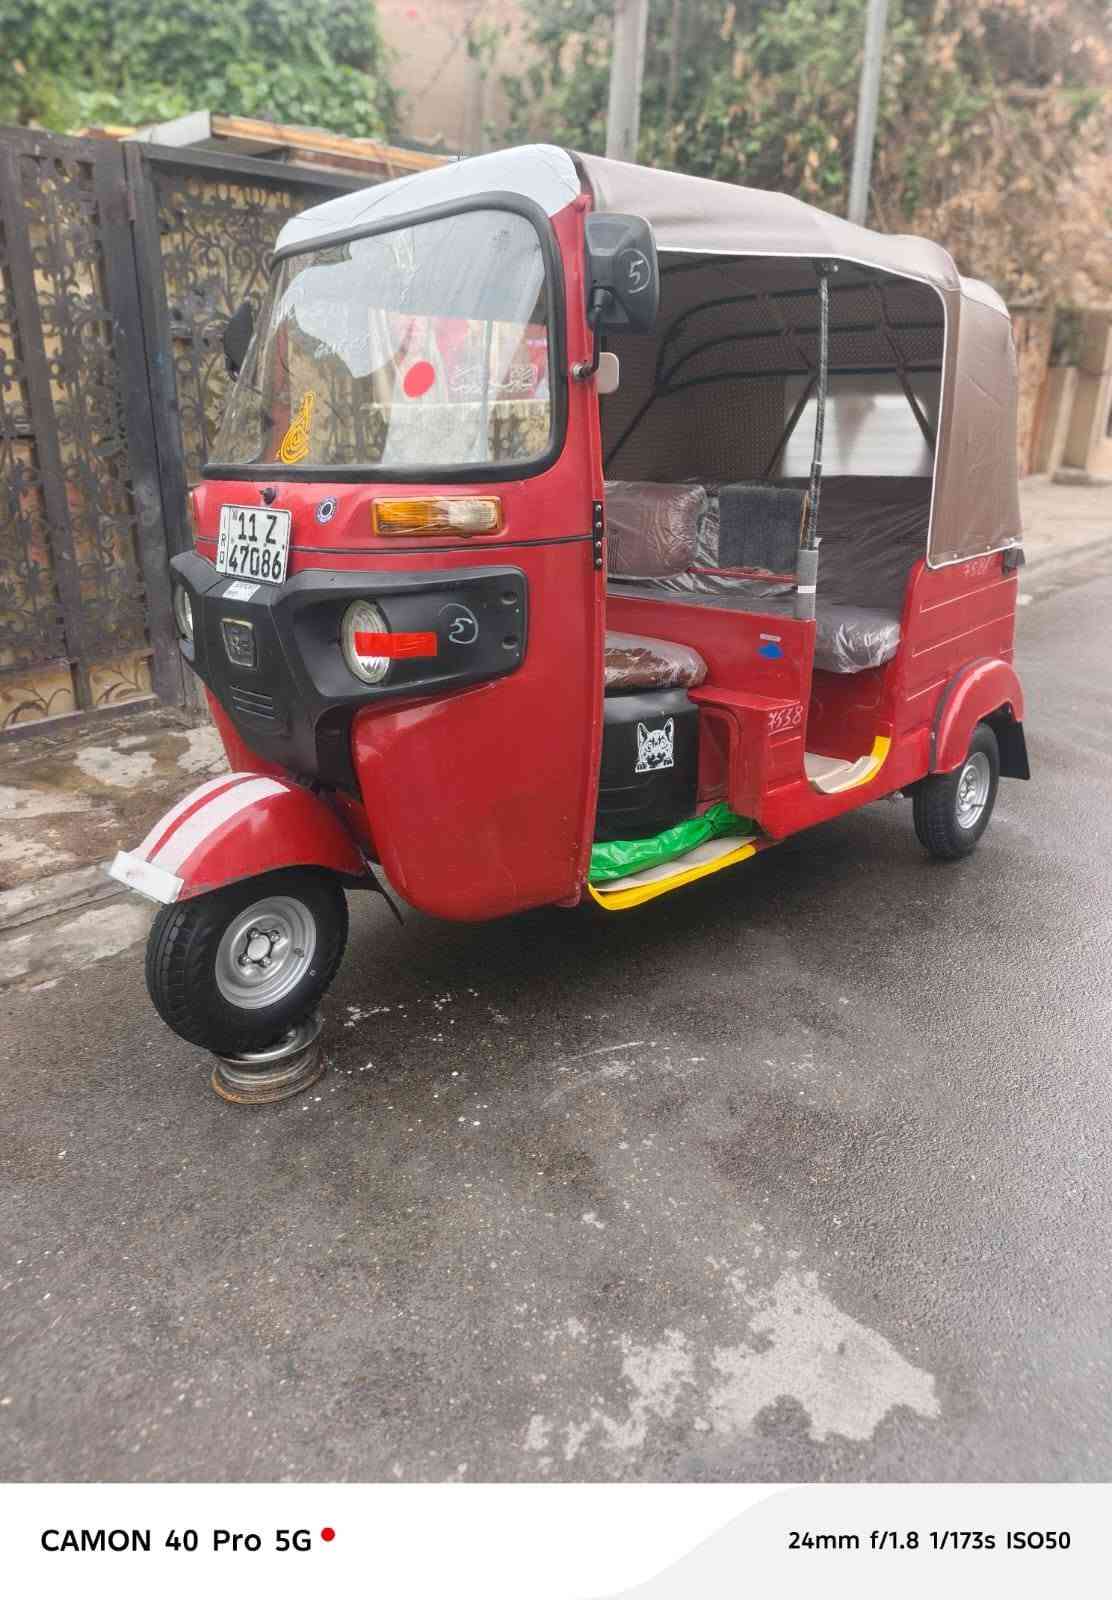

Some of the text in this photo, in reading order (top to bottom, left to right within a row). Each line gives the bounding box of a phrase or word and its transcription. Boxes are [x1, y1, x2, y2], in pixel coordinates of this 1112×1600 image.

[628, 259, 643, 284] 5
[238, 511, 258, 542] 11
[265, 514, 277, 544] Z
[228, 544, 282, 579] 47086
